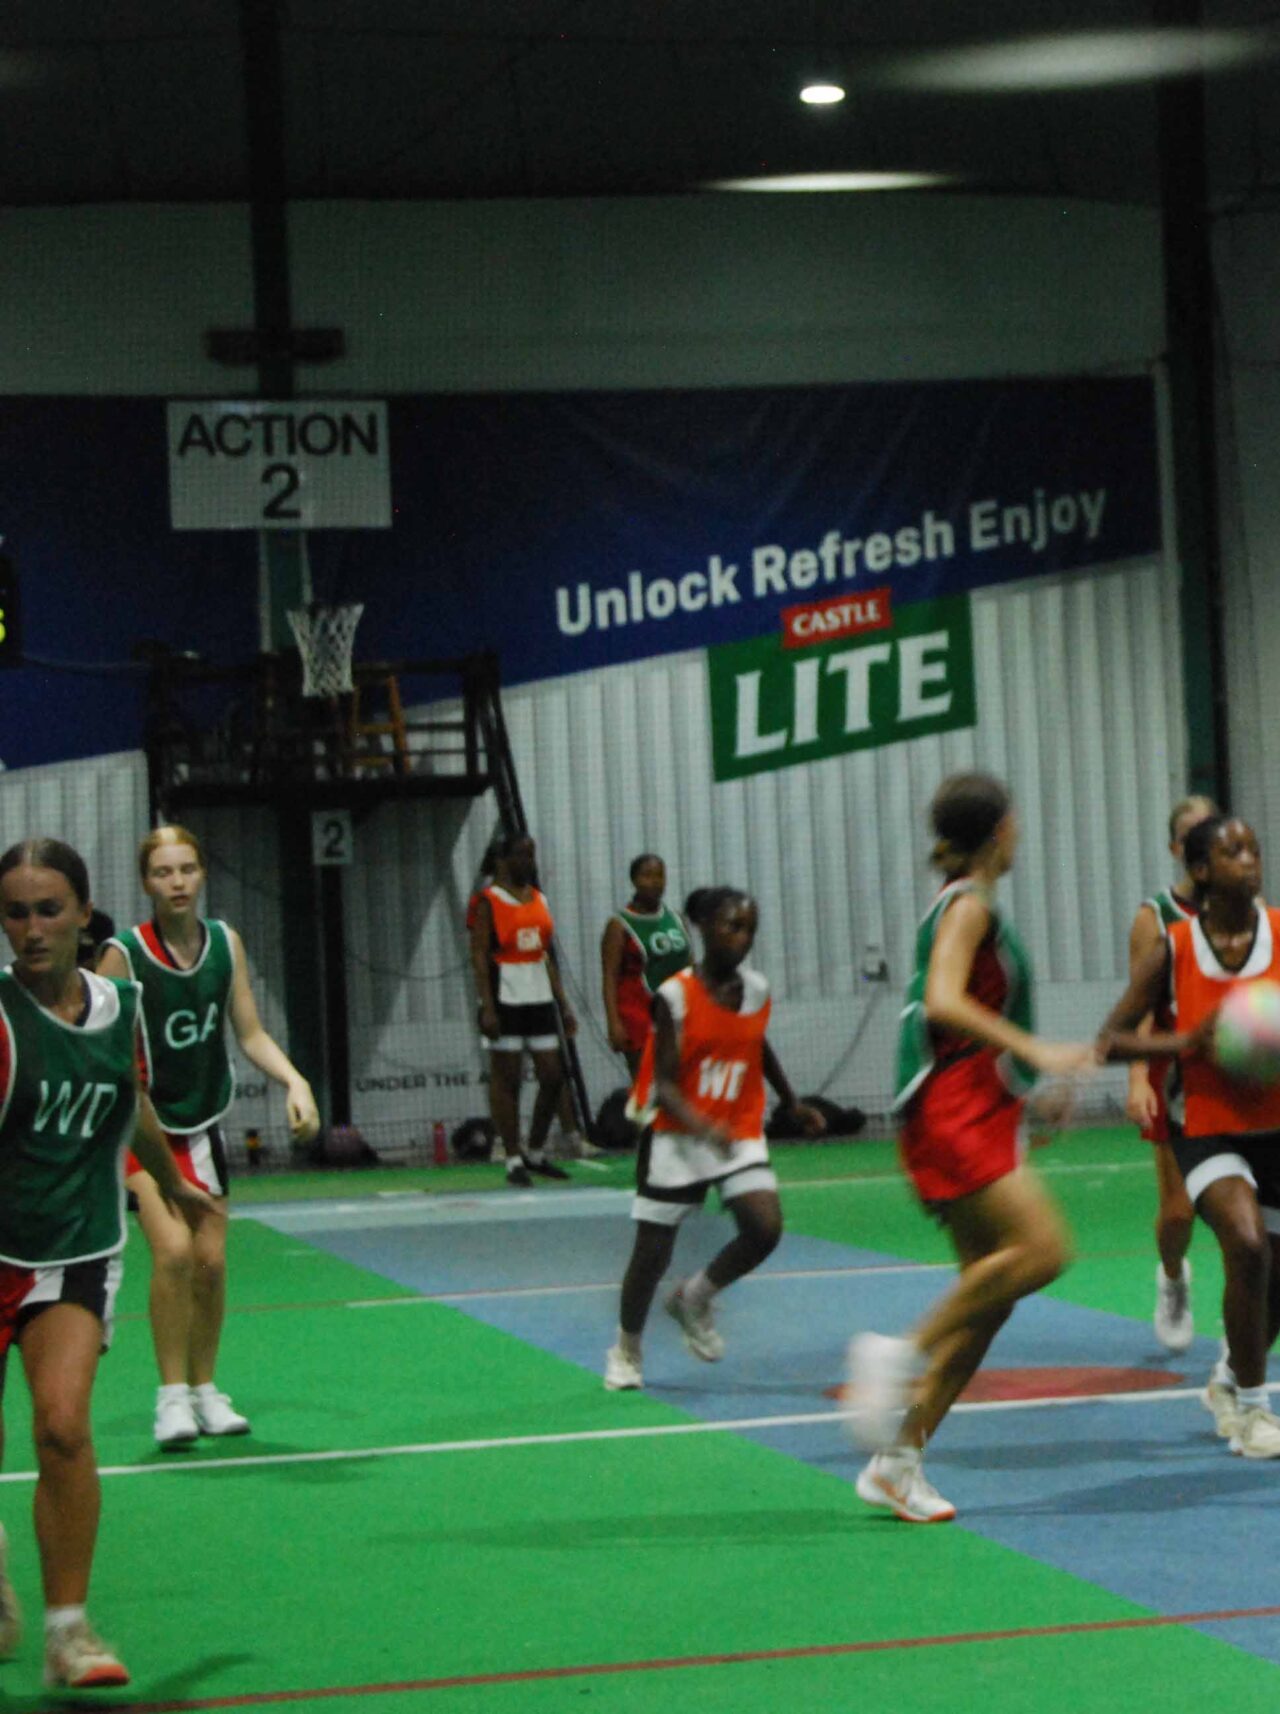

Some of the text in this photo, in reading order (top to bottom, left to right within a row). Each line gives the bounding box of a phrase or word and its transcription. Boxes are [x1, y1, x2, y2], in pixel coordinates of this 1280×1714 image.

[177, 412, 379, 457] ACTION
[261, 461, 302, 520] 2
[555, 488, 1105, 636] Unlock Refresh Enjoy
[792, 599, 882, 637] CASTLE
[734, 630, 953, 759] LITE
[323, 819, 346, 858] 2
[650, 928, 687, 956] GS
[355, 1073, 426, 1092] UNDER
[436, 1071, 470, 1087] THE
[33, 1080, 118, 1138] WD
